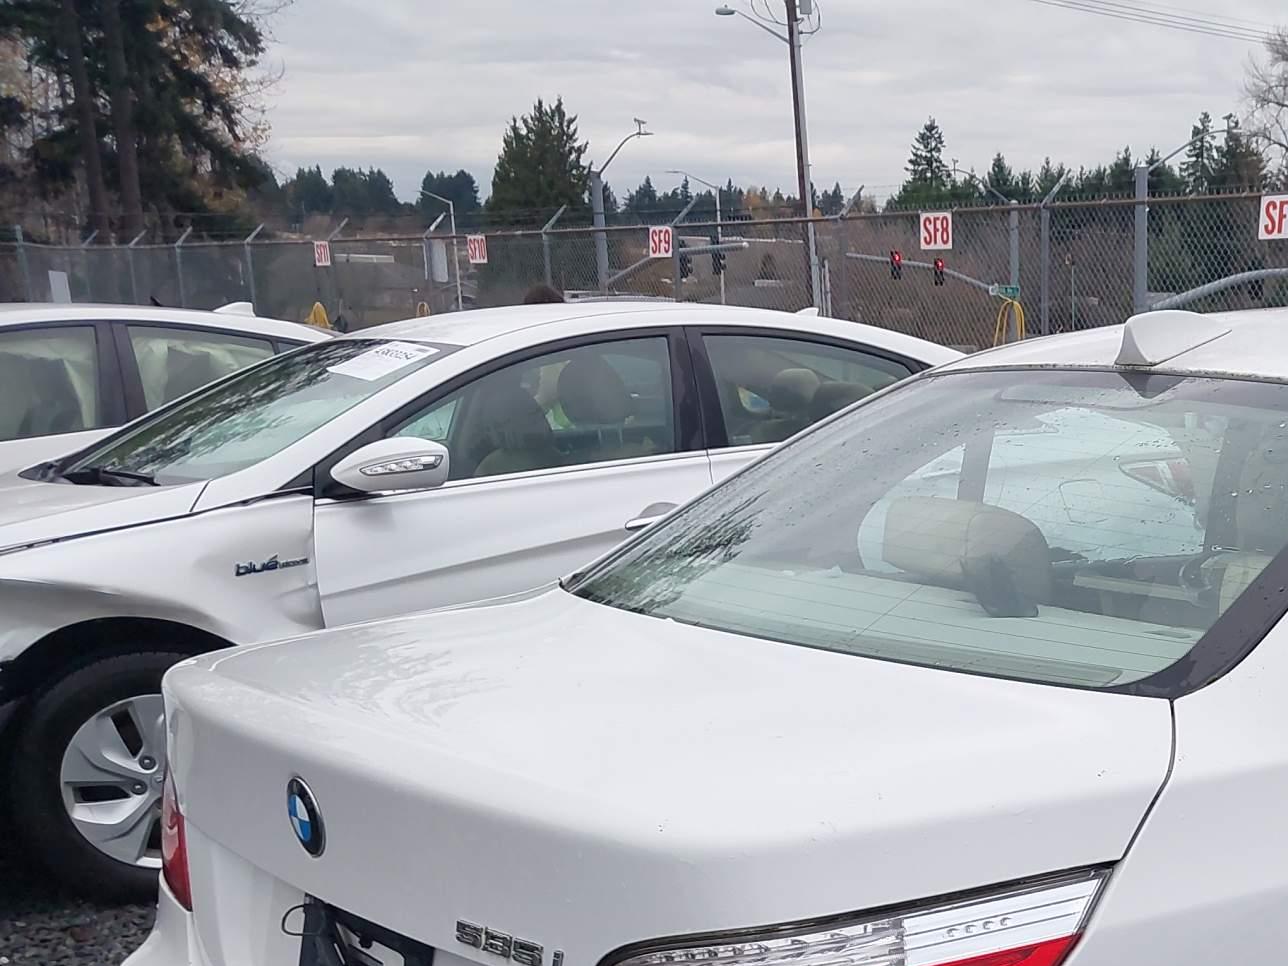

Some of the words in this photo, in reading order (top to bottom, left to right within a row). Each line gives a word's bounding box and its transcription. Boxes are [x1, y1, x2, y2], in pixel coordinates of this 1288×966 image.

[651, 229, 670, 254] SF9
[923, 215, 950, 246] SF8
[469, 237, 486, 260] SF10
